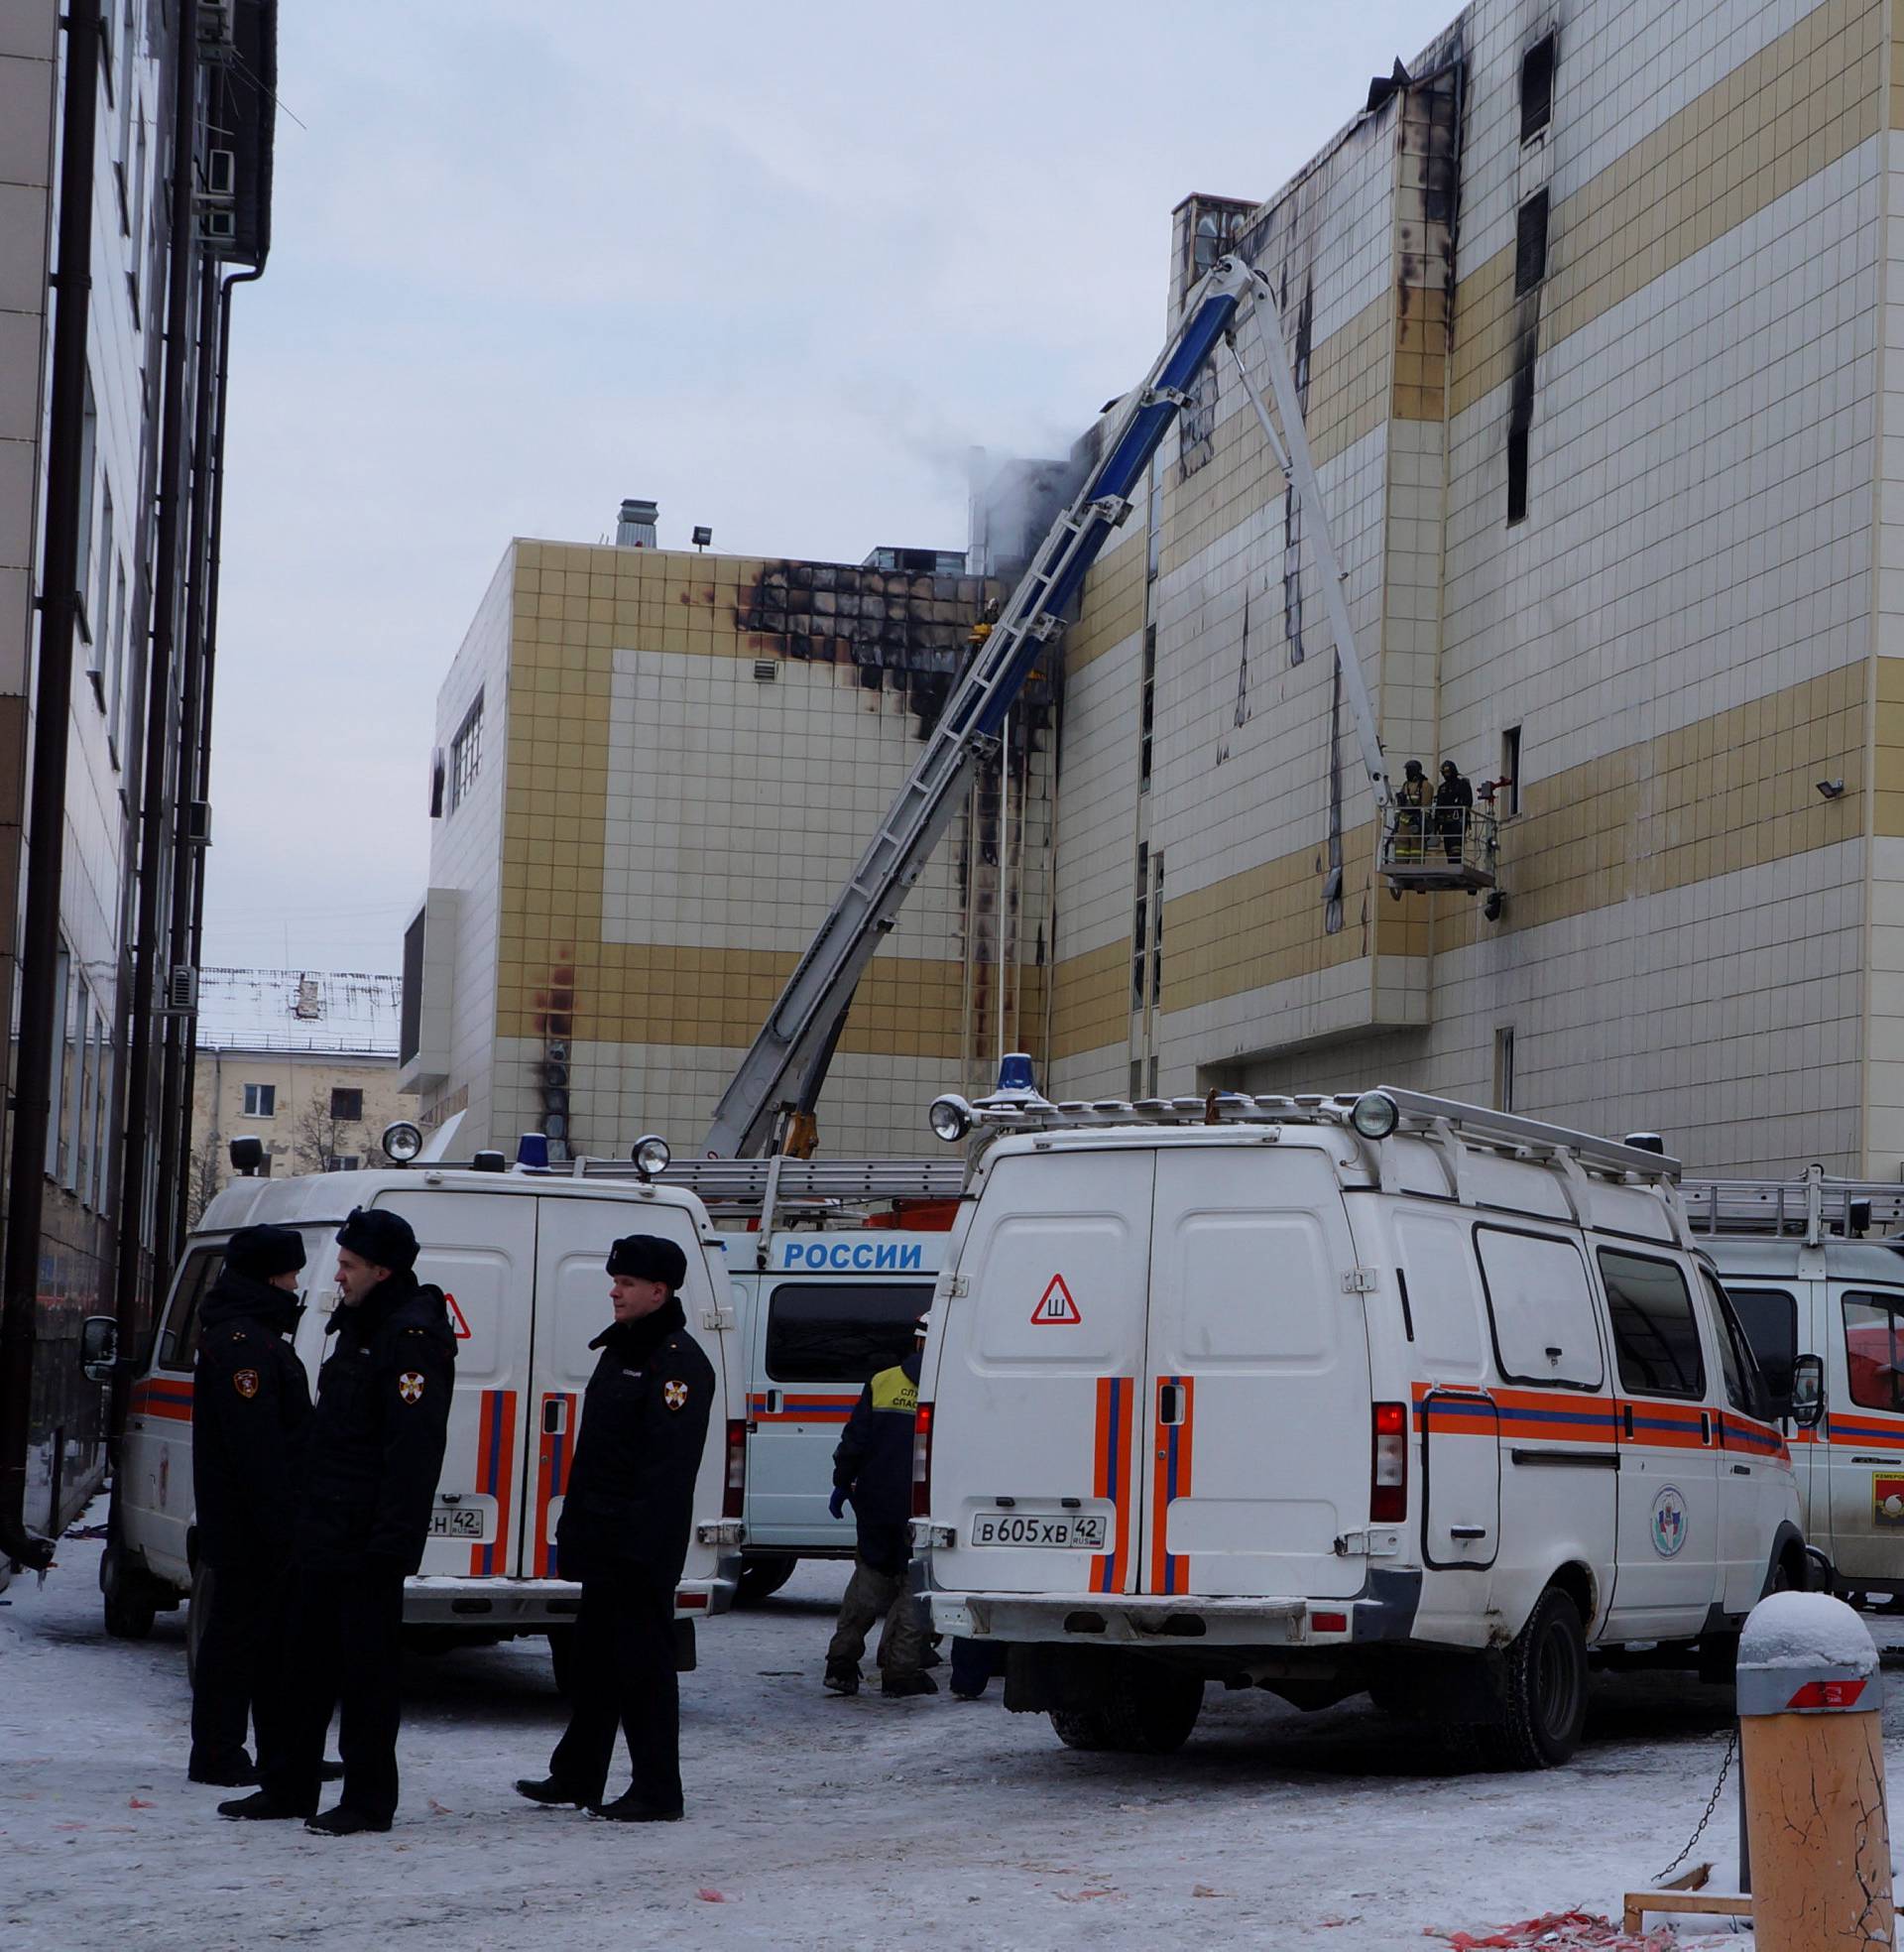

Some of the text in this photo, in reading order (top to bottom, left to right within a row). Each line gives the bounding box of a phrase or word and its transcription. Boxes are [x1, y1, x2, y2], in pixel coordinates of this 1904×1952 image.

[783, 1244, 921, 1269] РОССИИ
[1048, 1299, 1065, 1316] Ш
[453, 1512, 474, 1527] 42
[1075, 1520, 1097, 1537] 42
